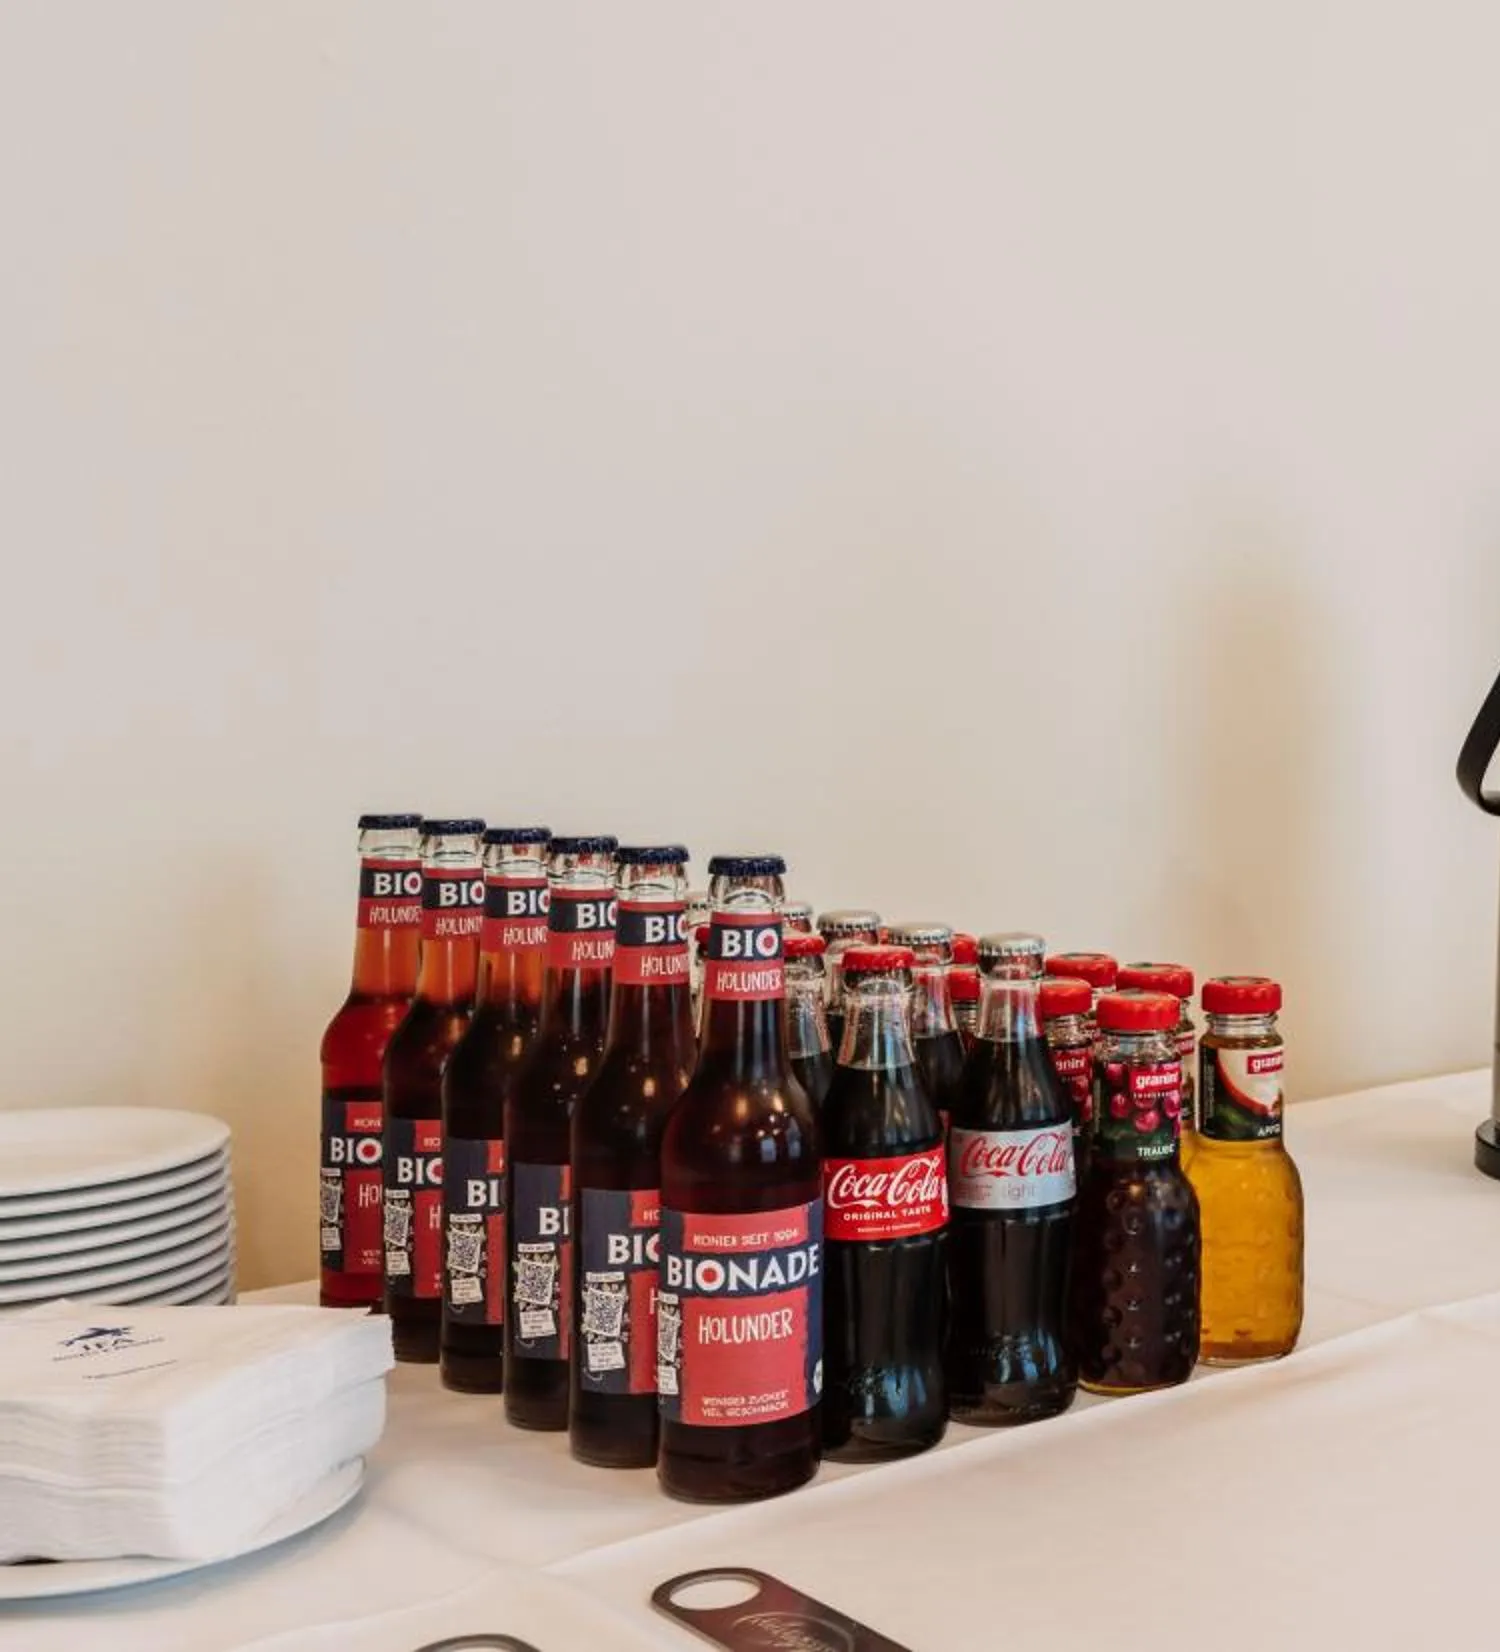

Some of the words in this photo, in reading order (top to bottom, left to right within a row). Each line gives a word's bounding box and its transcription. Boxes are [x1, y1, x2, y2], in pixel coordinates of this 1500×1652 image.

[373, 872, 422, 895] BIO
[439, 881, 485, 906] BIO
[721, 928, 778, 958] BIO
[716, 969, 783, 993] HOLUNDER
[330, 1136, 383, 1165] BIO
[843, 1210, 897, 1222] ORIGINAL
[901, 1204, 932, 1218] TASTE
[666, 1243, 820, 1292] BIONADE
[698, 1307, 794, 1345] HOLUNDER
